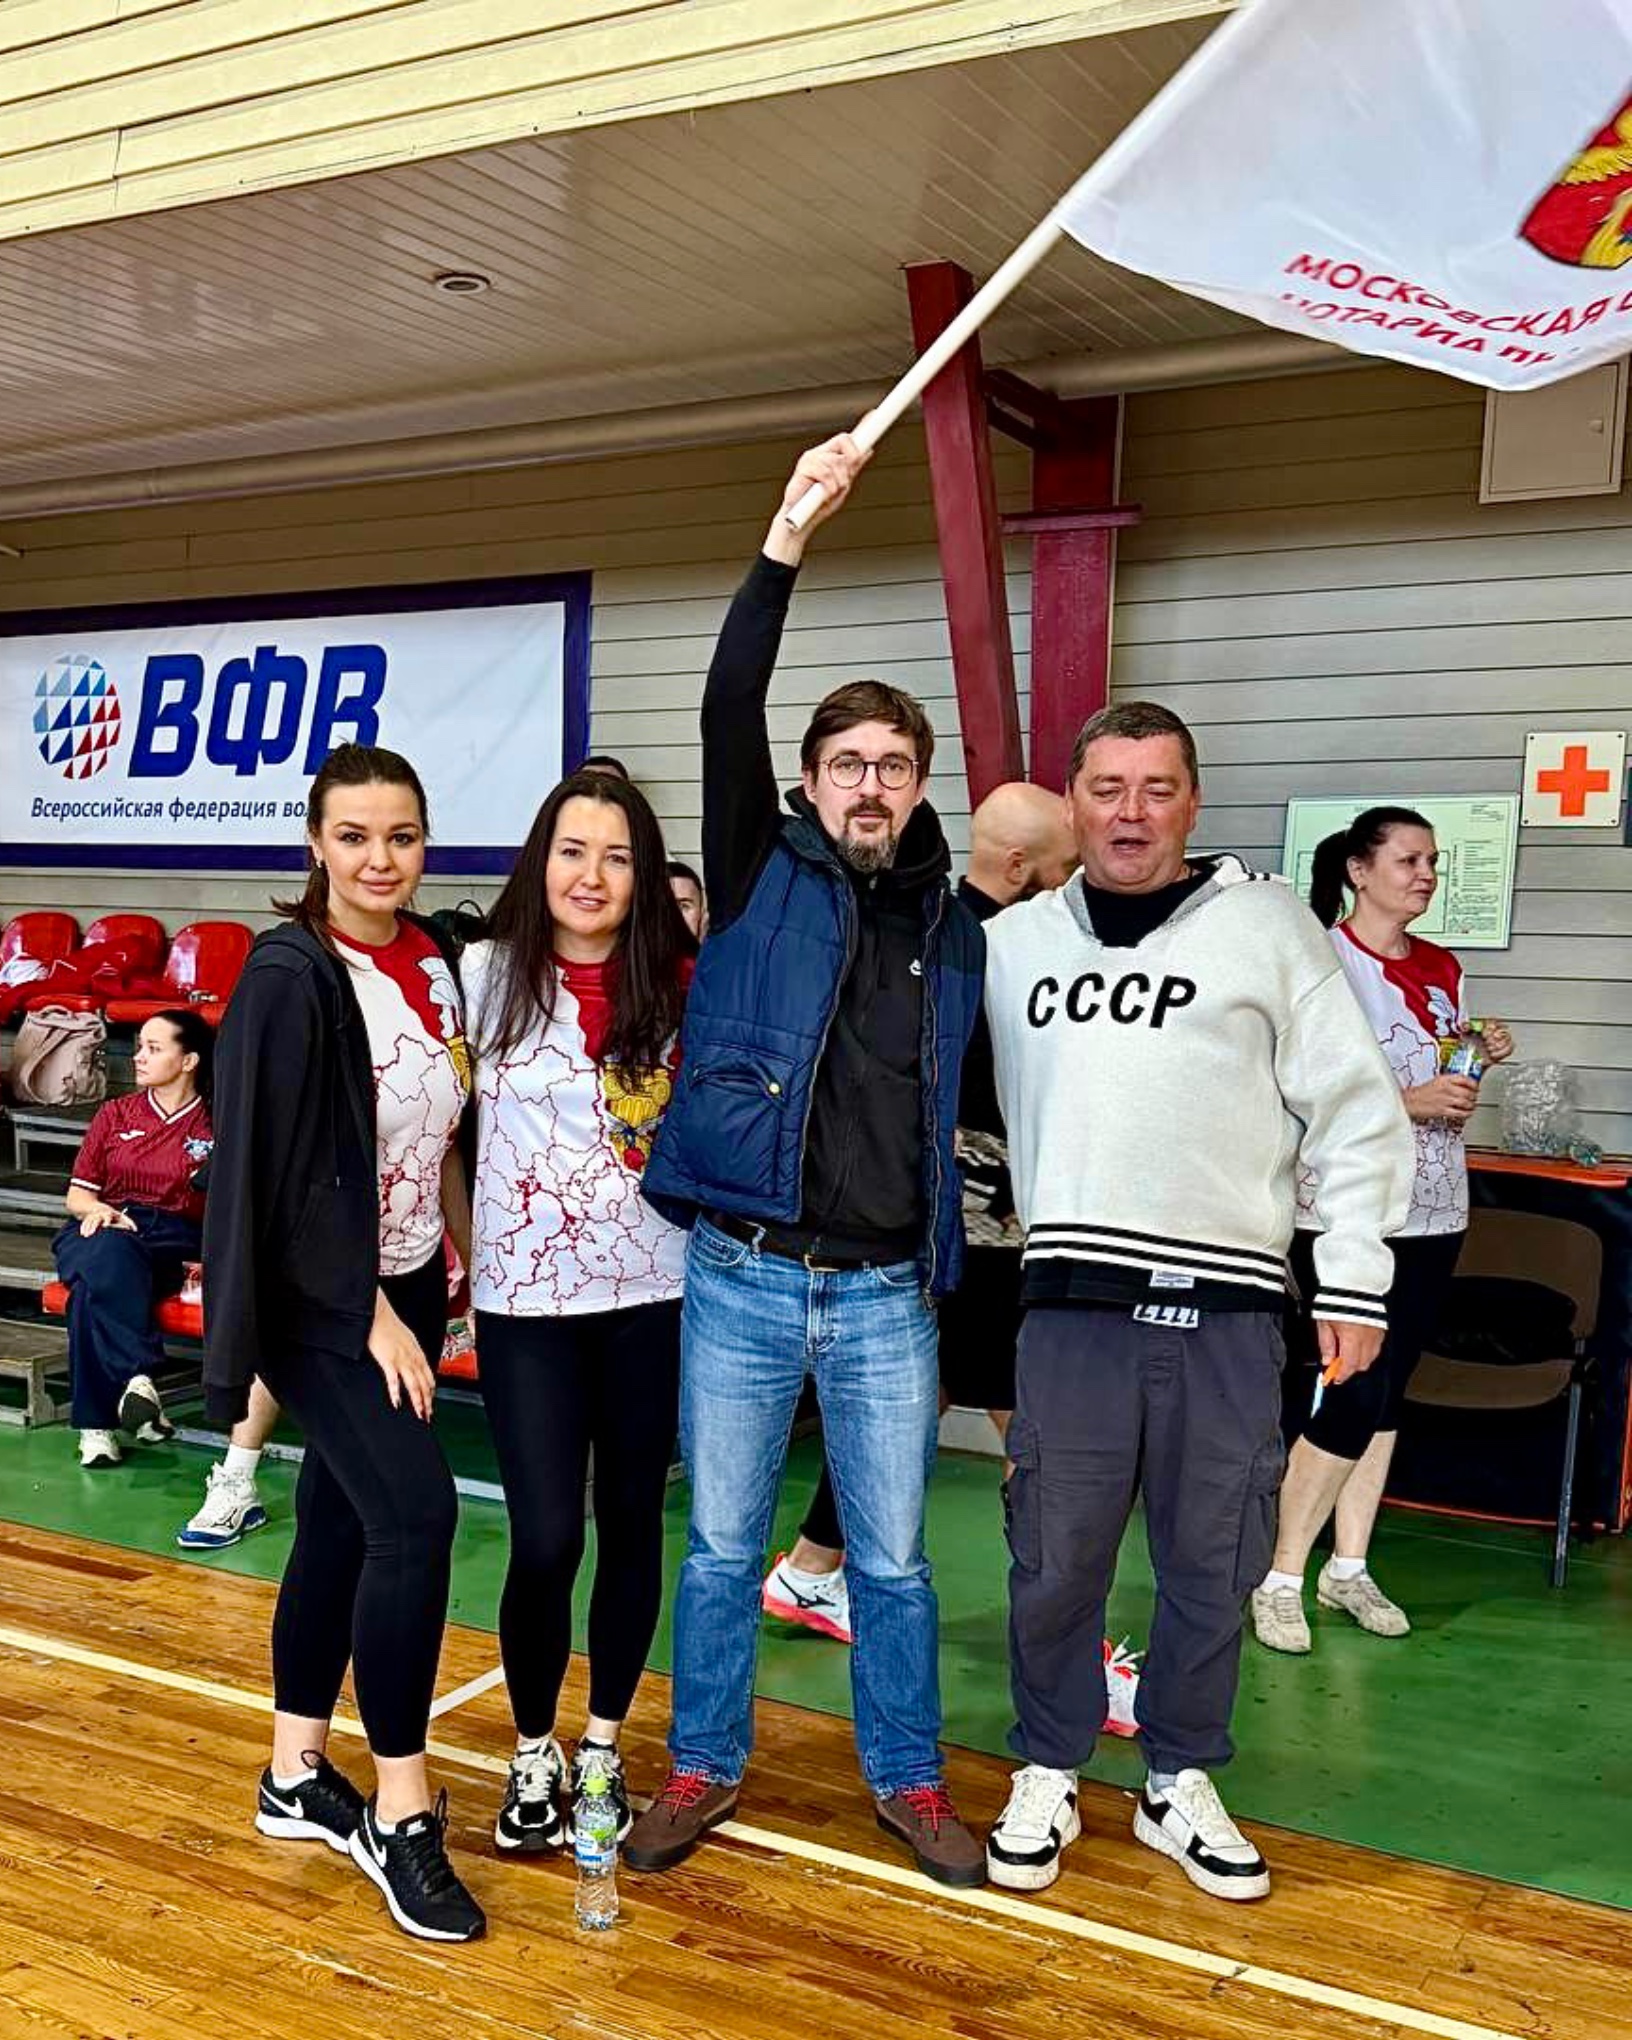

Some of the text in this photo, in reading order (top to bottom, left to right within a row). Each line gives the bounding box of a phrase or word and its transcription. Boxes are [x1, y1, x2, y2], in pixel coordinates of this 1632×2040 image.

[1284, 254, 1614, 336] МОСКОВСКАЯ
[128, 644, 387, 778] ВФВ
[31, 796, 309, 822] Всероссийская федерация во
[1027, 972, 1197, 1029] СССР
